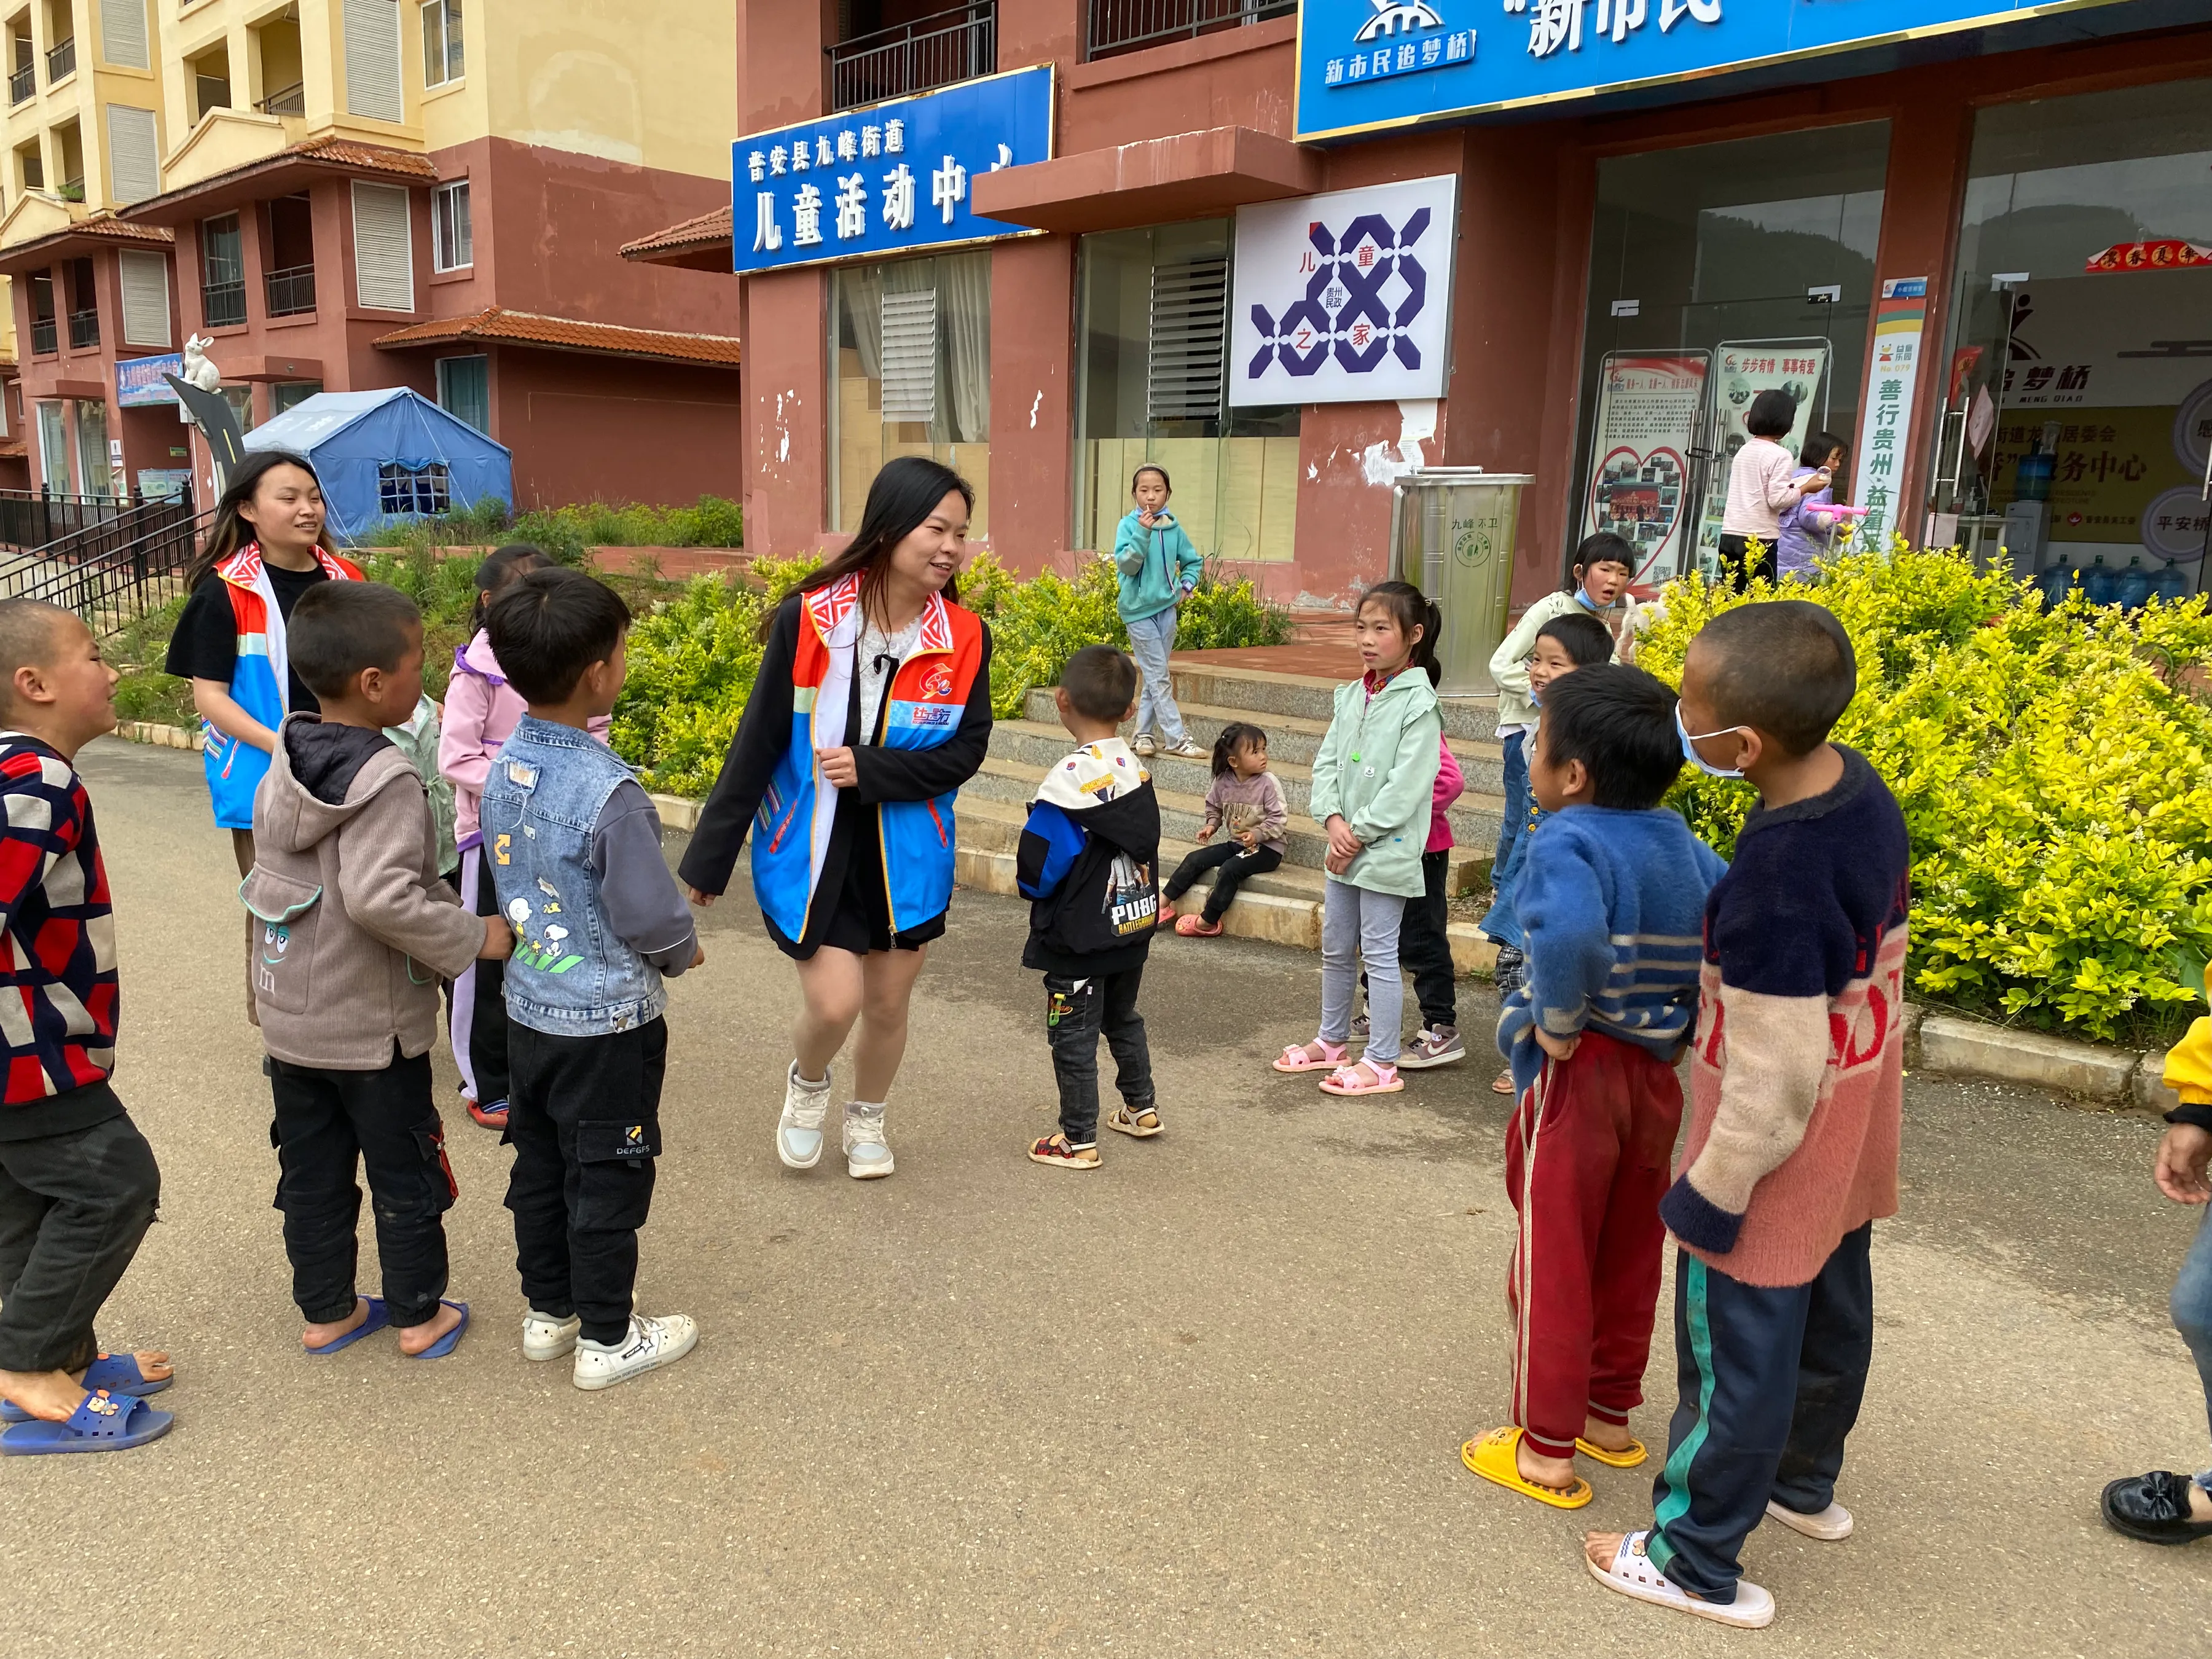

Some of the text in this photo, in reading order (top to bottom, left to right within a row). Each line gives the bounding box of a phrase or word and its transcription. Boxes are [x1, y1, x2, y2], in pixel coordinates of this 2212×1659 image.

[1325, 32, 1470, 85] 新市民追梦桥
[748, 118, 906, 182] 普安县九峰街道
[1326, 286, 1343, 297] 贵州
[1326, 297, 1343, 308] 民政
[1741, 358, 1776, 374] 步步有情
[1782, 358, 1816, 375] 事事有爱
[1111, 893, 1157, 926] PUBG
[616, 1145, 650, 1155] DEFGFS
